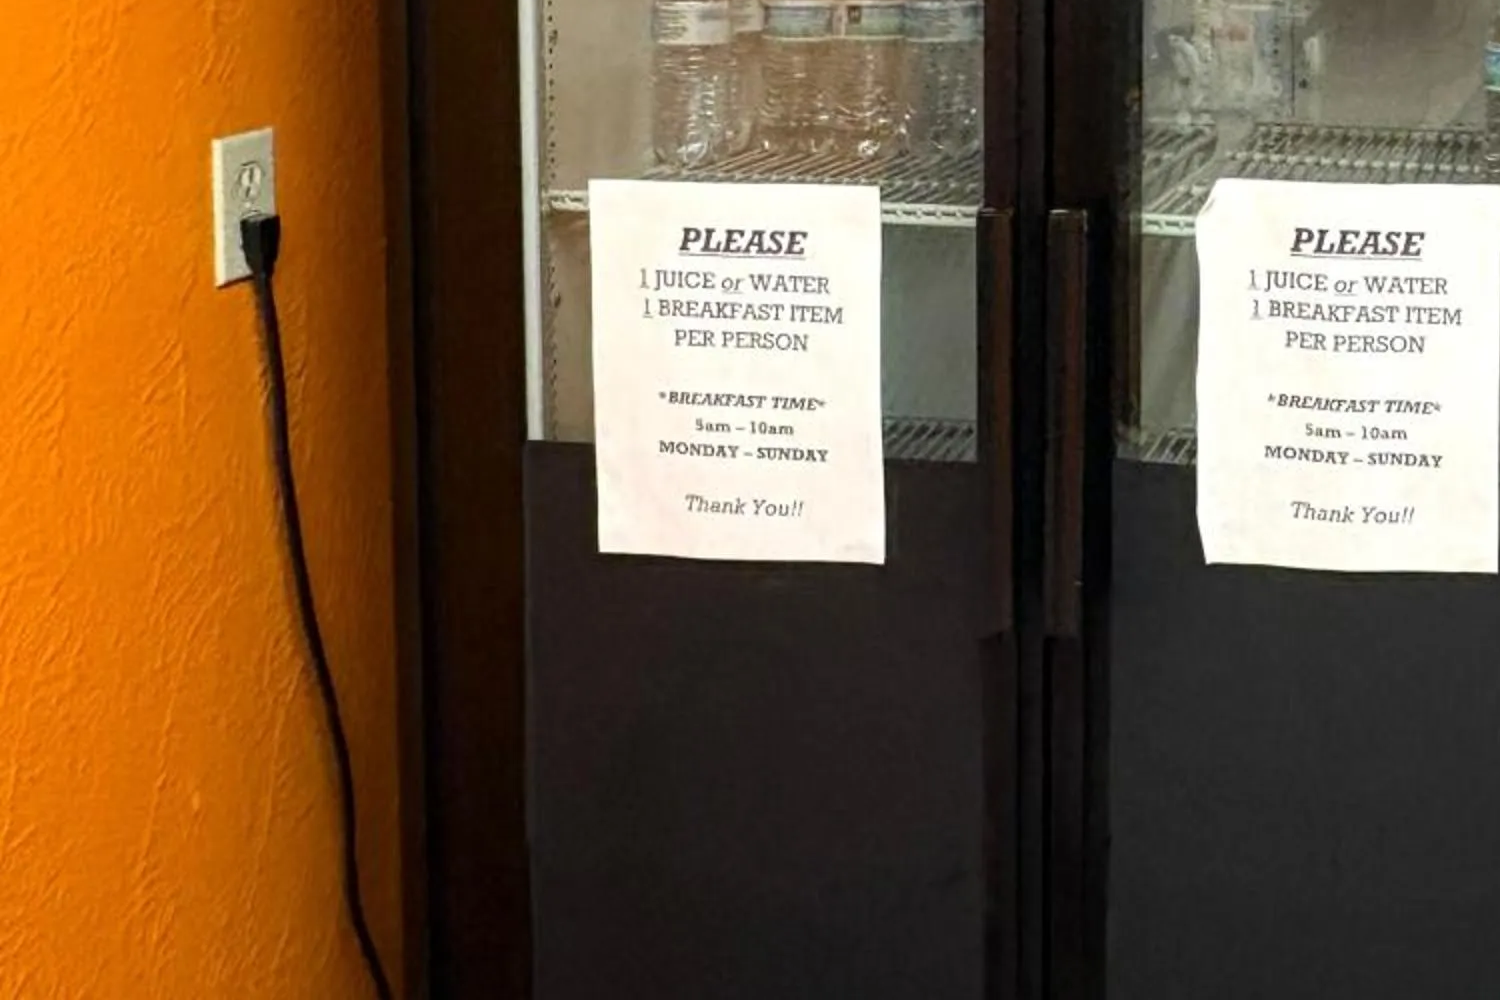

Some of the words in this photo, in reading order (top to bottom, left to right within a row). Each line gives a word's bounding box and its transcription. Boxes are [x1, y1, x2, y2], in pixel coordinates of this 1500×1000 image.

[678, 226, 809, 261] PLEASE
[1289, 226, 1426, 261] PLEASE
[638, 268, 651, 289] 1
[653, 269, 716, 292] JUICE
[720, 276, 745, 294] or
[748, 273, 831, 295] WATER
[1248, 269, 1258, 290] 1
[1263, 269, 1329, 293] JUICE
[1333, 279, 1358, 297] or
[1363, 275, 1448, 295] WATER
[642, 297, 654, 319] 1
[658, 298, 785, 322] BREAKFAST
[789, 303, 844, 325] ITEM
[1251, 298, 1261, 319] 1
[1268, 299, 1400, 324] BREAKFAST
[1404, 305, 1463, 327] ITEM
[674, 328, 716, 348] PER
[721, 330, 809, 352] PERSON
[1284, 330, 1327, 351] PER
[1332, 334, 1426, 354] PERSON
[695, 418, 732, 433] 5am
[750, 420, 795, 436] 10am
[1305, 422, 1342, 439] 5am
[1361, 425, 1408, 441] 10am
[659, 439, 740, 459] MONDAY
[756, 446, 829, 463] SUNDAY
[1264, 444, 1350, 466] MONDAY
[1367, 452, 1444, 469] SUNDAY
[684, 493, 747, 516] Thank
[752, 498, 804, 517] You!!
[1290, 500, 1355, 524] Thank
[1361, 506, 1415, 524] You!!
